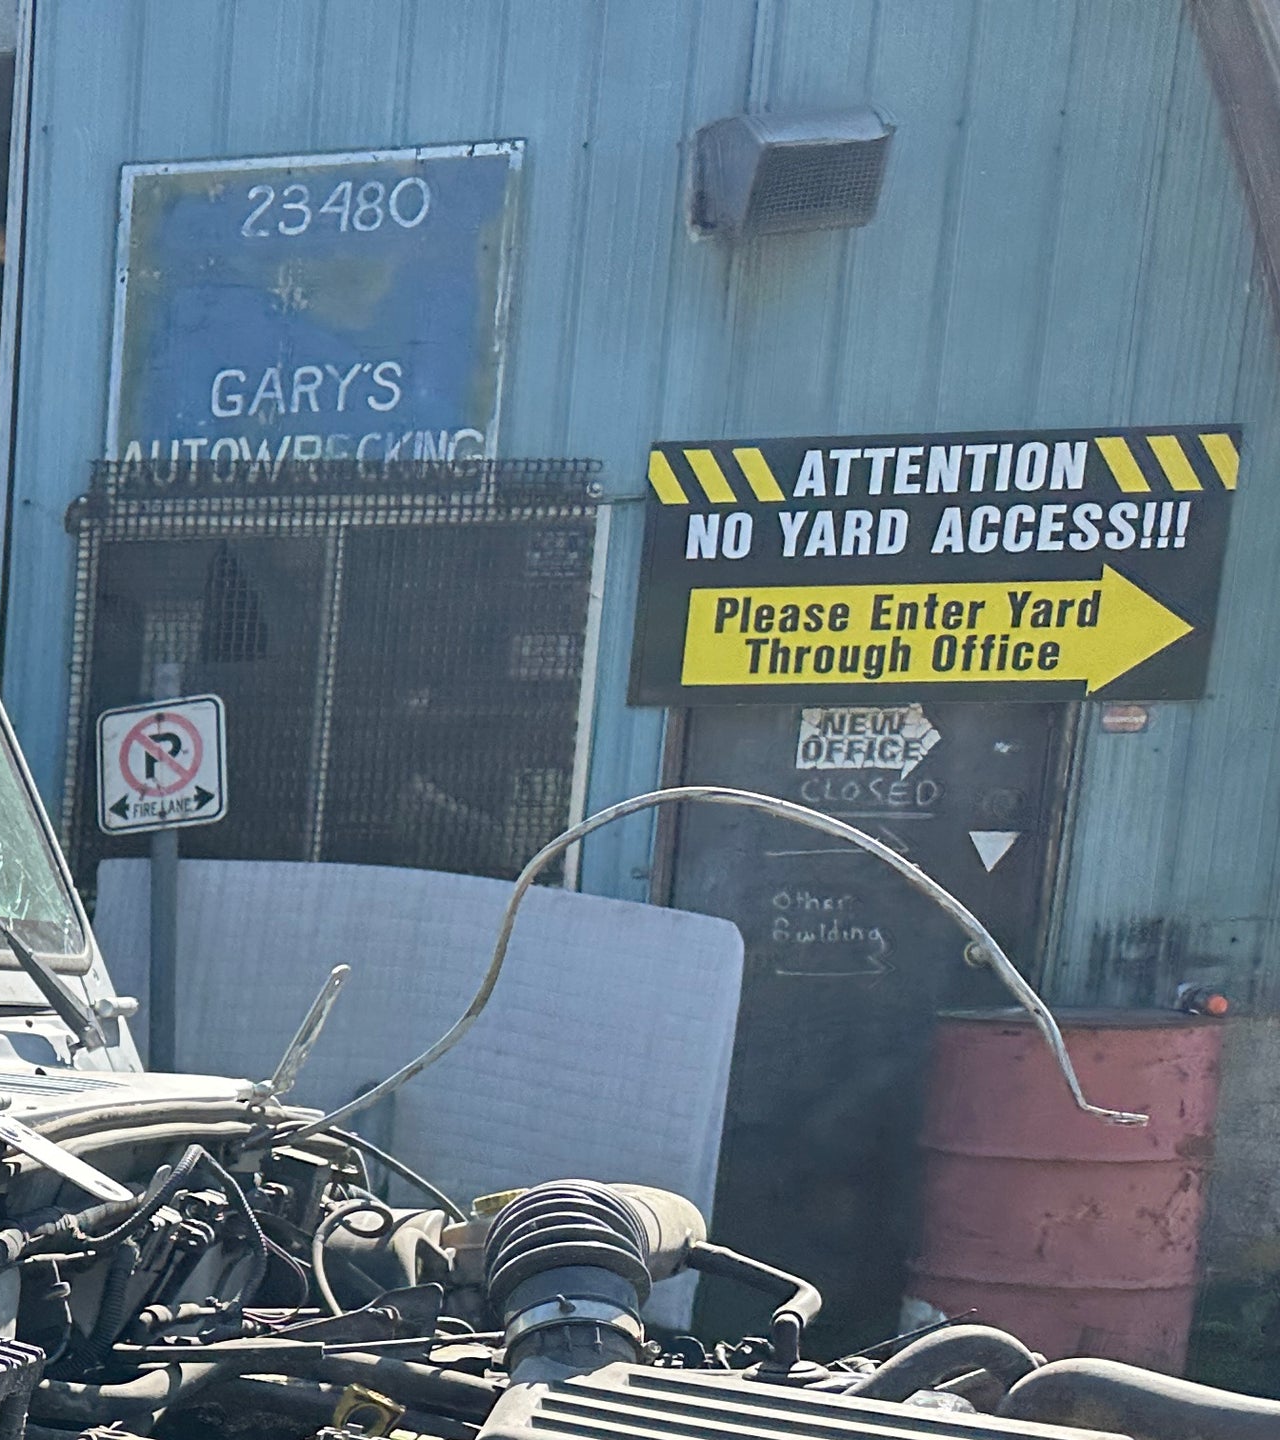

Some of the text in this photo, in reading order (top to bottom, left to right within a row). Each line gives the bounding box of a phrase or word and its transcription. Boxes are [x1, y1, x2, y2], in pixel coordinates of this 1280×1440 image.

[241, 176, 431, 238] 23480
[211, 361, 403, 418] GARY'S
[793, 441, 1088, 497] ATTENTION
[686, 501, 1192, 560] NO YARD ACCESS!!!
[714, 590, 1102, 634] Please Enter Yard
[746, 634, 1061, 679] Through Office
[821, 711, 905, 735] NEW
[802, 735, 923, 764] OFFICE
[132, 797, 192, 819] FIRE LANE
[801, 777, 938, 806] CLOSED
